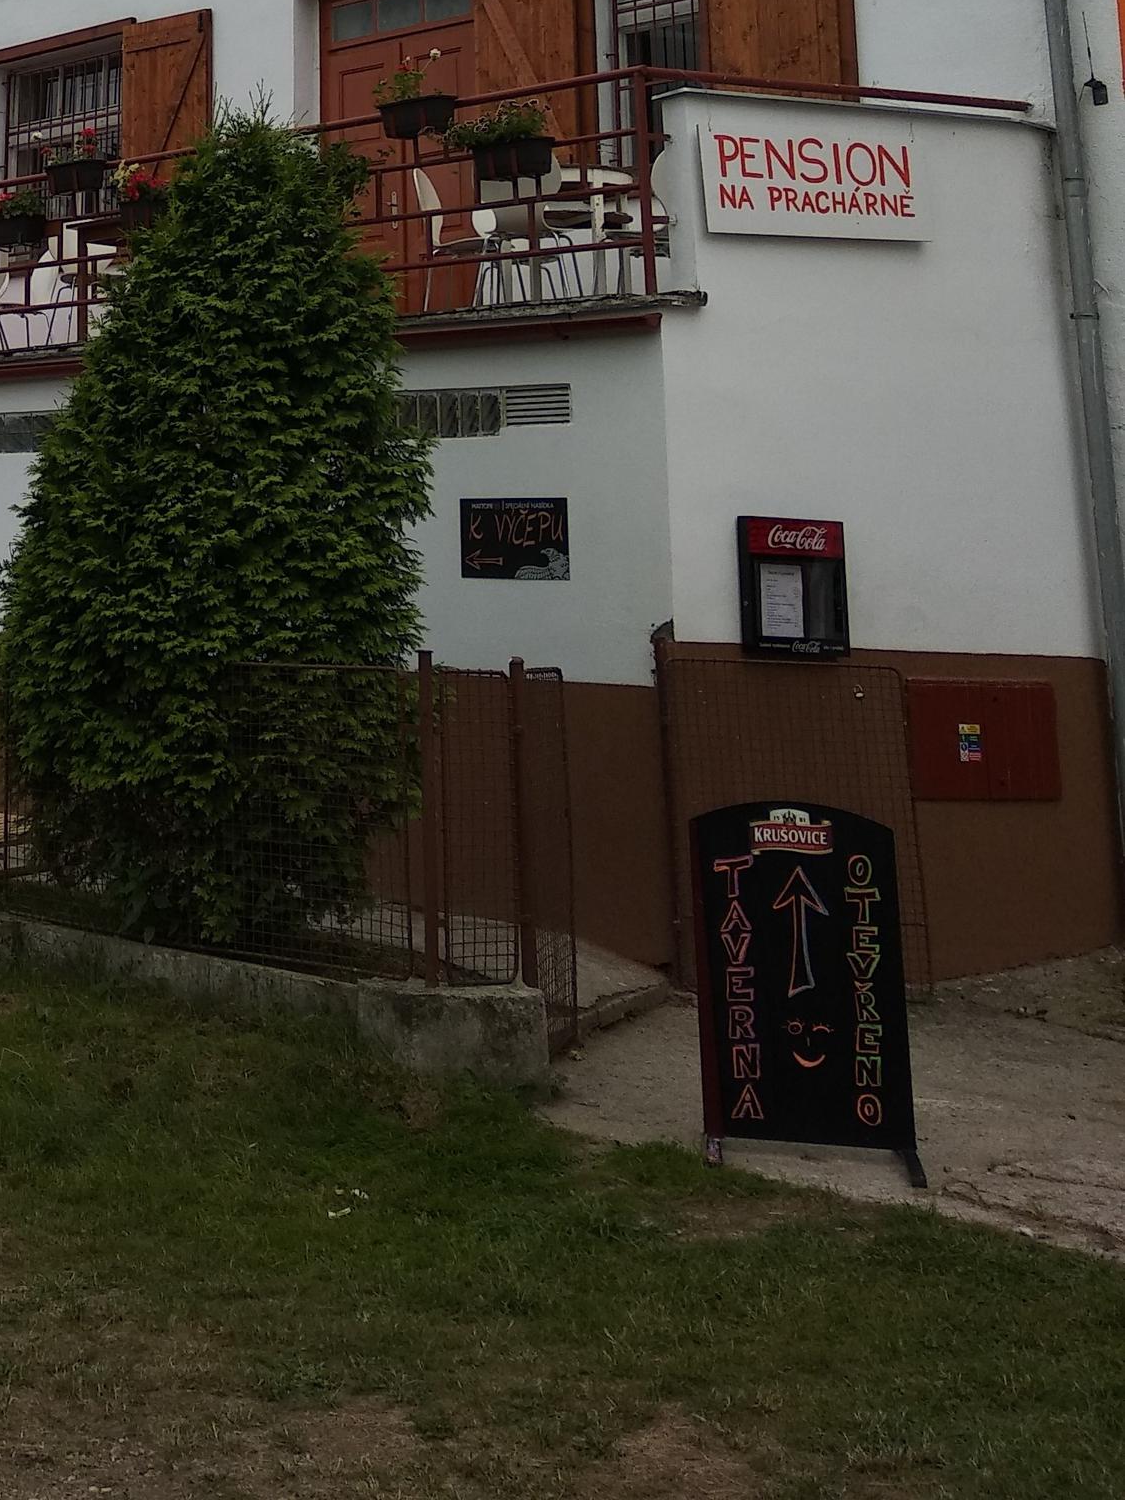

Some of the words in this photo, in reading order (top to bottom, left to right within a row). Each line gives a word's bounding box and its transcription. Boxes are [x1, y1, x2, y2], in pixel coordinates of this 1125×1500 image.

[713, 134, 911, 189] PENSION
[719, 183, 755, 211] NA
[767, 186, 916, 218] PRACHÁRNĚ
[469, 512, 484, 540] K
[494, 509, 564, 547] VÝČEPU
[767, 523, 828, 551] Coca-Cola
[754, 826, 828, 845] KRUŠOVICE
[713, 854, 765, 1120] TAVERNA
[843, 854, 883, 1126] OTEVŘENO
